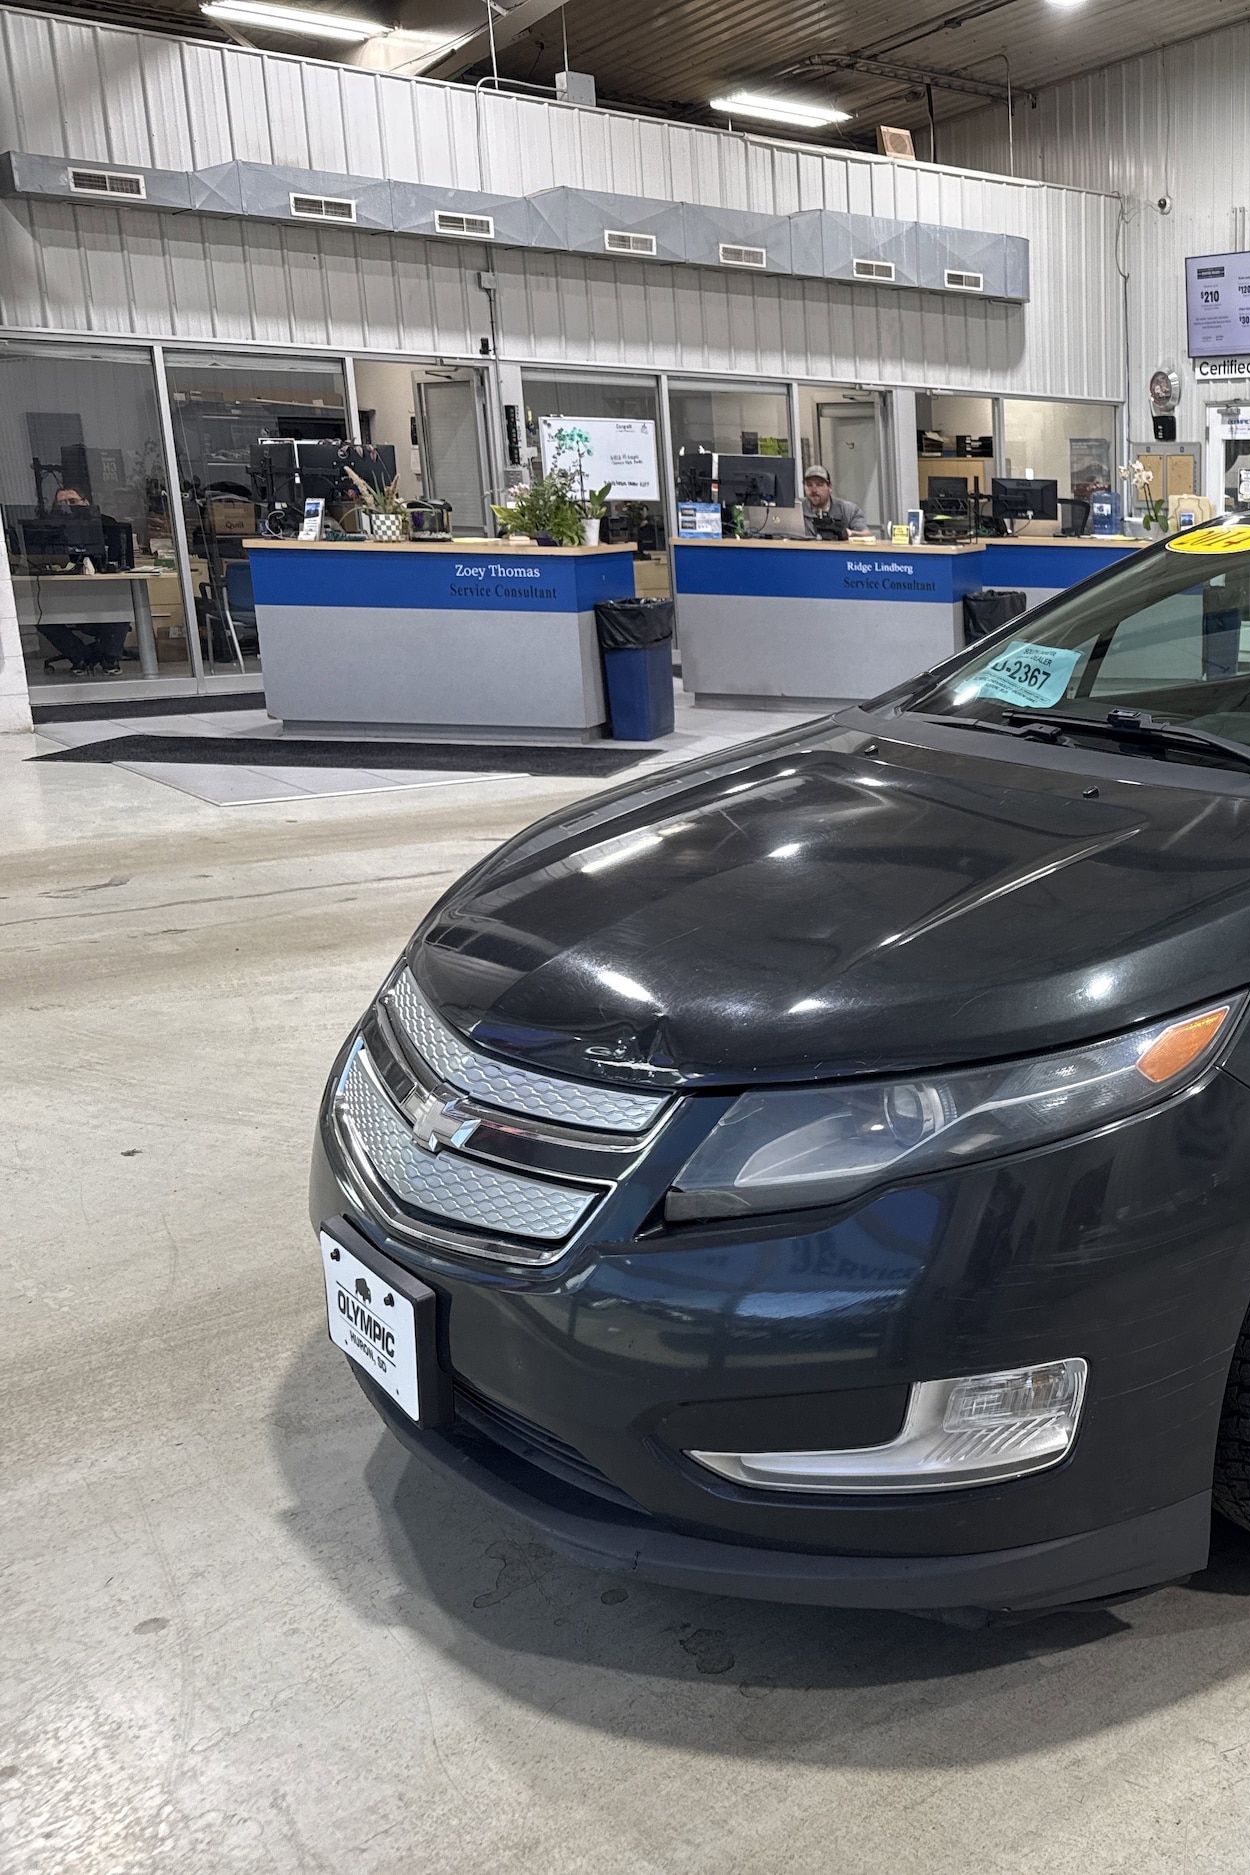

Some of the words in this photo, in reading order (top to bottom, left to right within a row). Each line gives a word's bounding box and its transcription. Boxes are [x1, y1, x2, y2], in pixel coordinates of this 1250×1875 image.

[1200, 290, 1220, 303] $210
[1239, 316, 1250, 325] $30
[455, 564, 486, 580] Zoey
[488, 564, 541, 577] Thomas
[846, 561, 872, 574] Ridge
[874, 562, 914, 575] Lindberg
[843, 577, 880, 589] Service
[882, 578, 936, 591] Consultant
[450, 584, 491, 597] Service
[494, 584, 557, 599] Consultant
[337, 1289, 396, 1358] OLYMPIC
[349, 1330, 377, 1366] HURON,
[377, 1355, 388, 1374] SD
